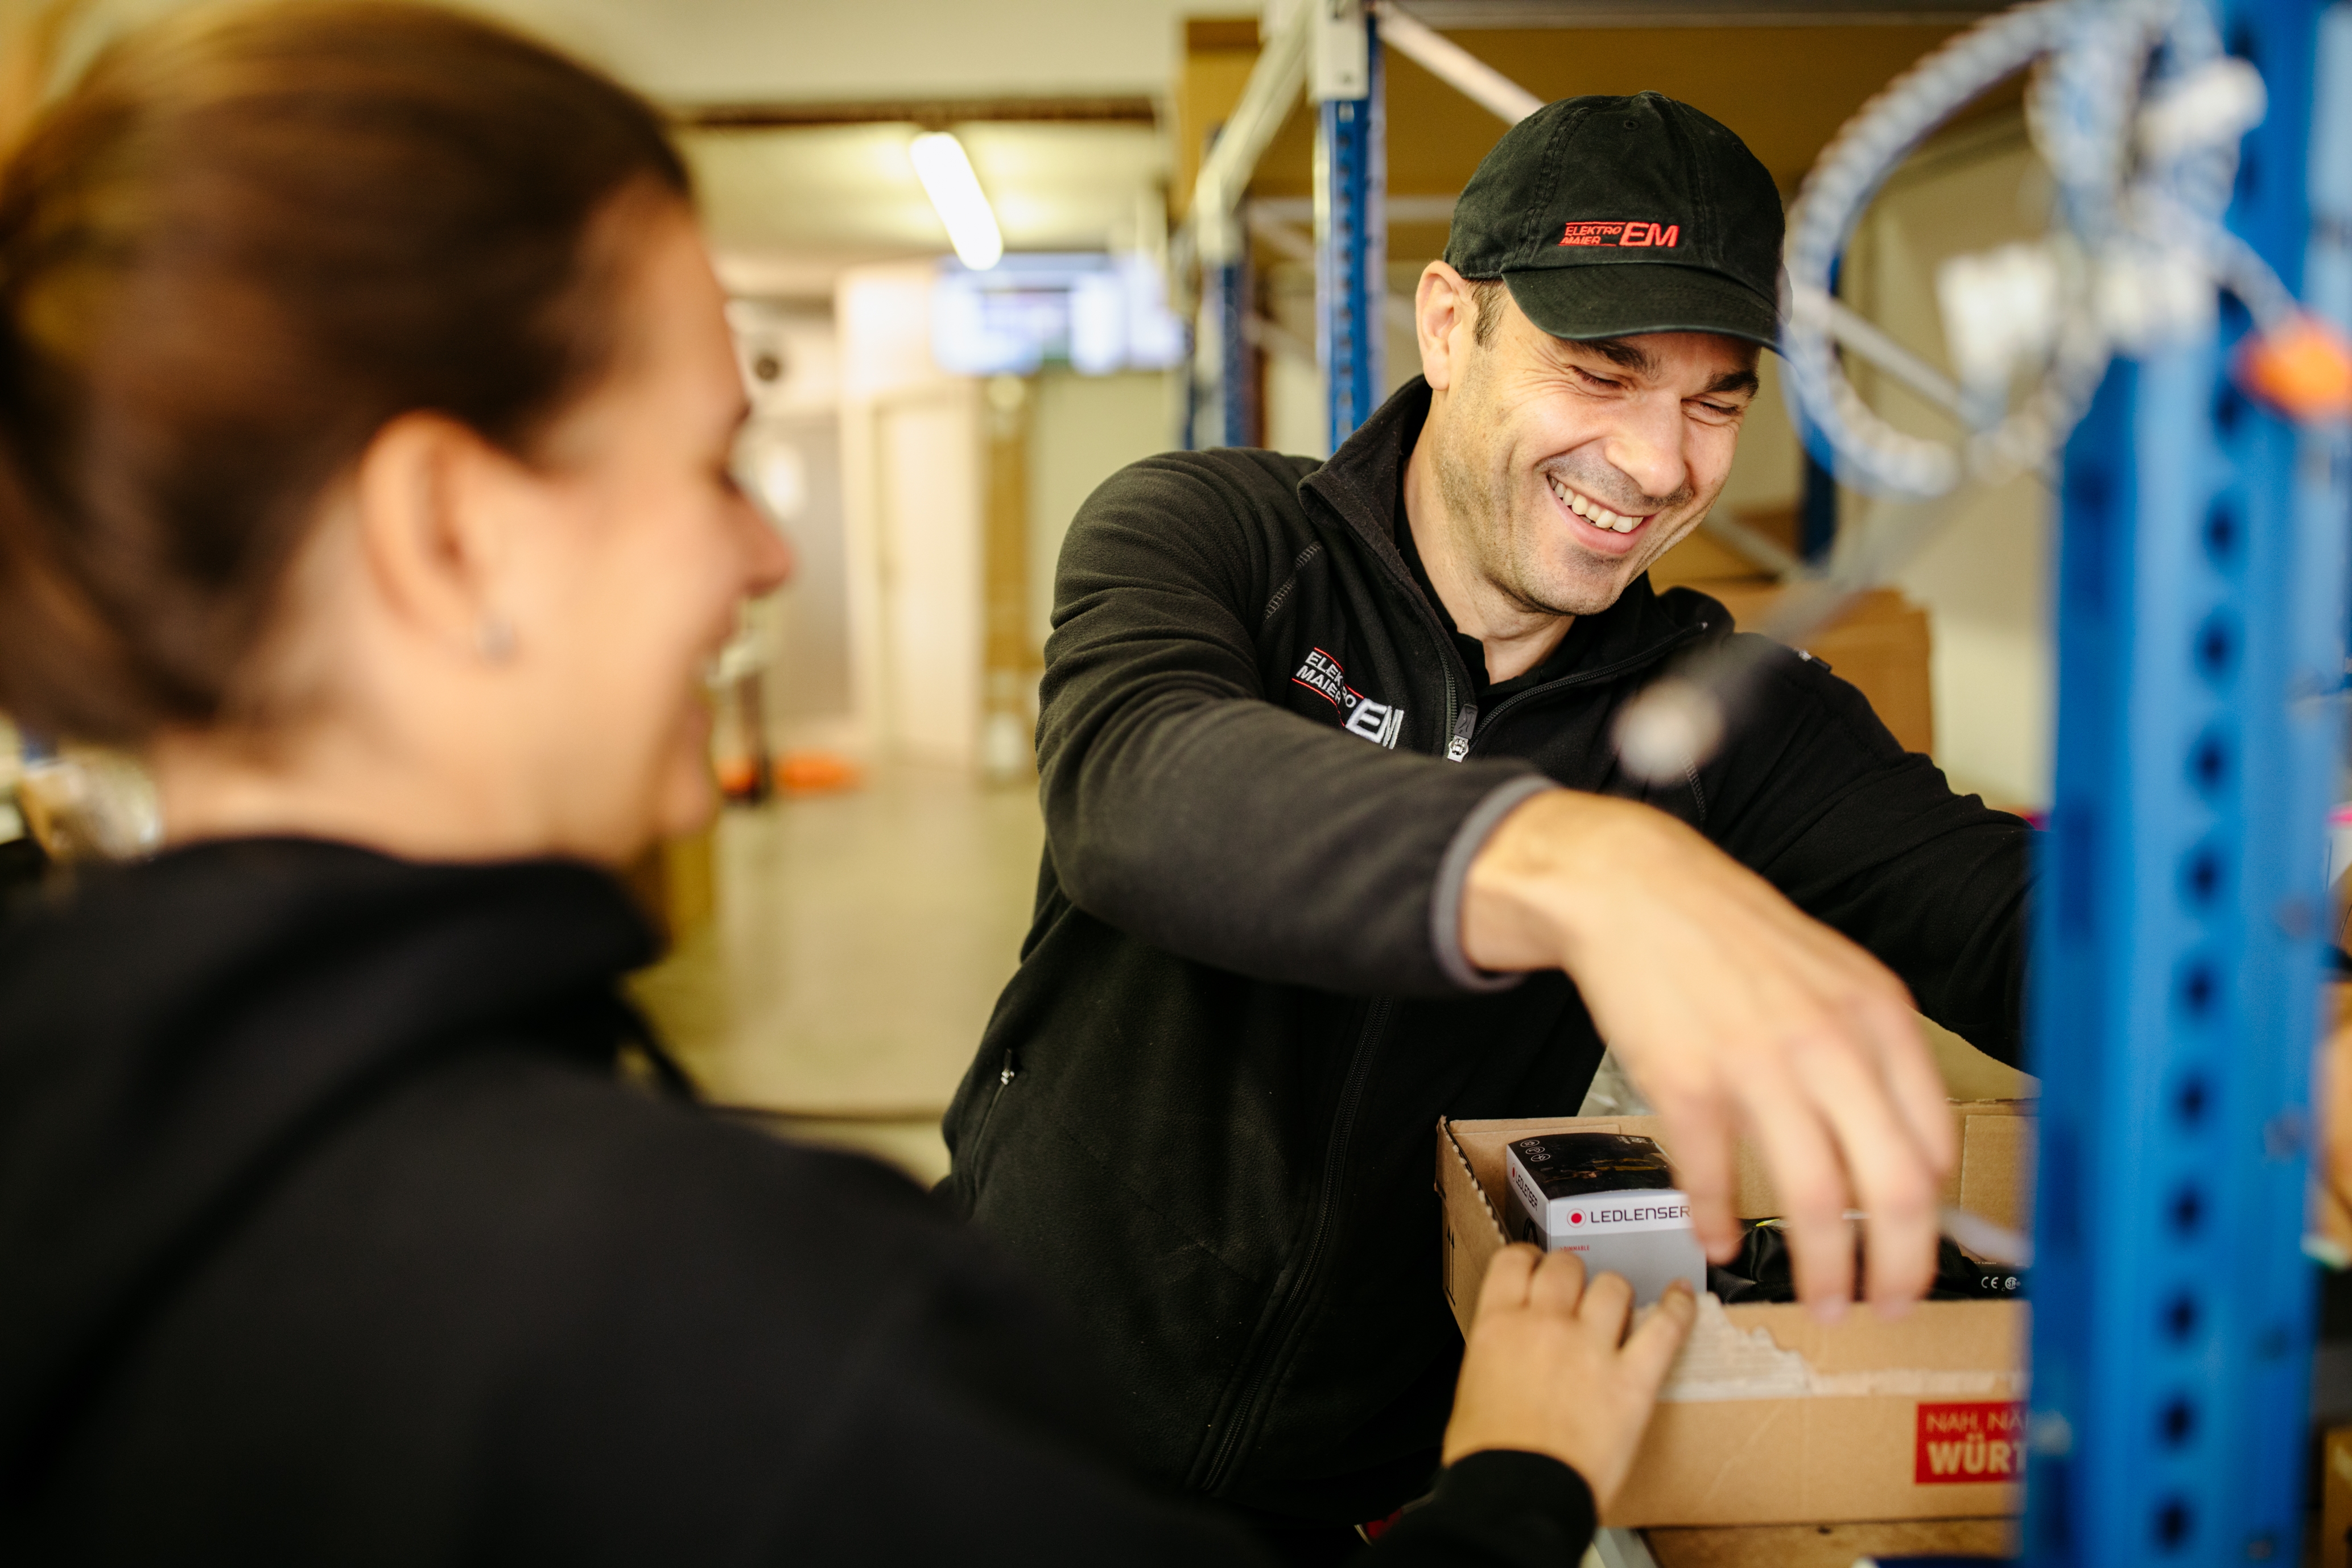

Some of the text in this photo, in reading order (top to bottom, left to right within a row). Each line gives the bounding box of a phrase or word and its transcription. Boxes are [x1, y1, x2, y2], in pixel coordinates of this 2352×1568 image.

[1560, 236, 1601, 245] MAIER
[1565, 226, 1621, 236] ELEKTRO
[1619, 222, 1680, 247] EM
[1295, 665, 1341, 704] MAIER
[1345, 698, 1404, 749] EM
[1515, 1171, 1538, 1211] LEDLENSER
[1591, 1206, 1690, 1223] LEDLENSER
